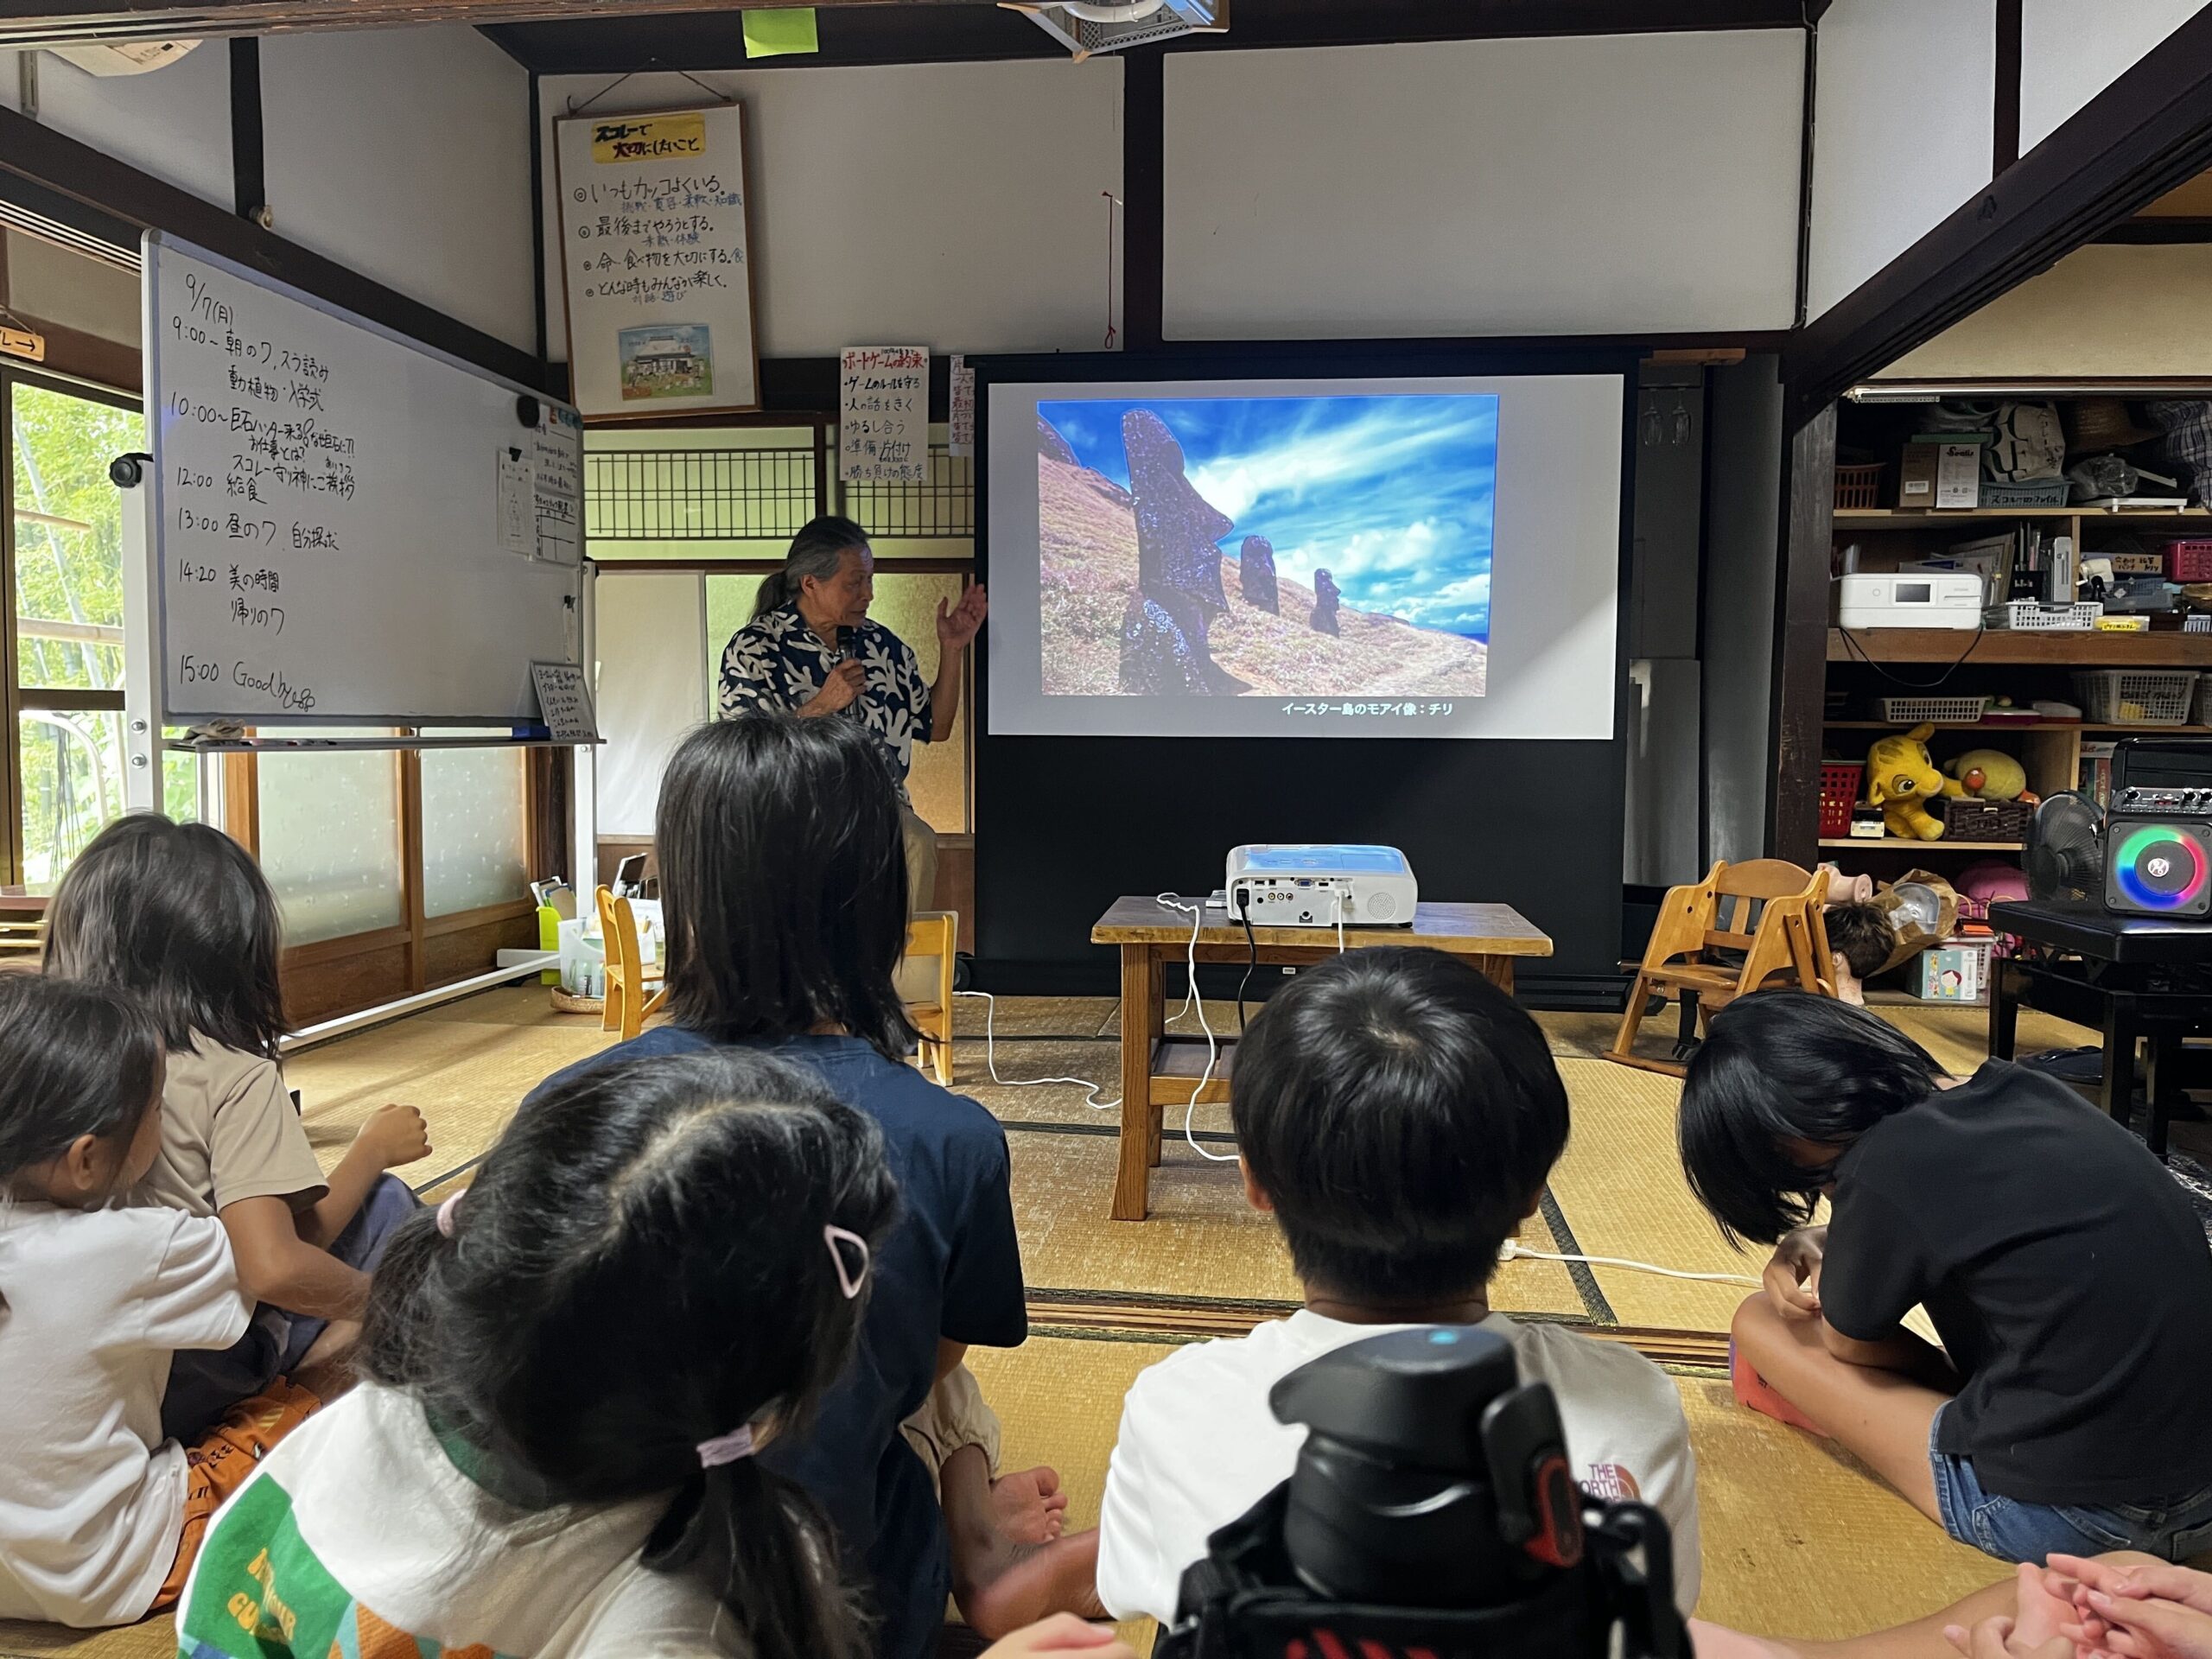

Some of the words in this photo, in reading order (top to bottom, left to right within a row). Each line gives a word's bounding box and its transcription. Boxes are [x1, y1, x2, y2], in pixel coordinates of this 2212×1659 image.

[186, 274, 233, 325] 9/7(月)
[849, 397, 912, 412] 人の話をきく
[850, 419, 905, 435] ゆるし合う
[177, 467, 213, 487] 12:00
[226, 473, 268, 504] 給食
[179, 507, 218, 531] 13:00
[179, 559, 216, 582] 14:20
[228, 563, 279, 593] 美の時間
[231, 597, 284, 636] 帰りのワ
[181, 655, 219, 684] 15:00
[1588, 1463, 1616, 1480] THE
[1579, 1479, 1621, 1501] ORTH
